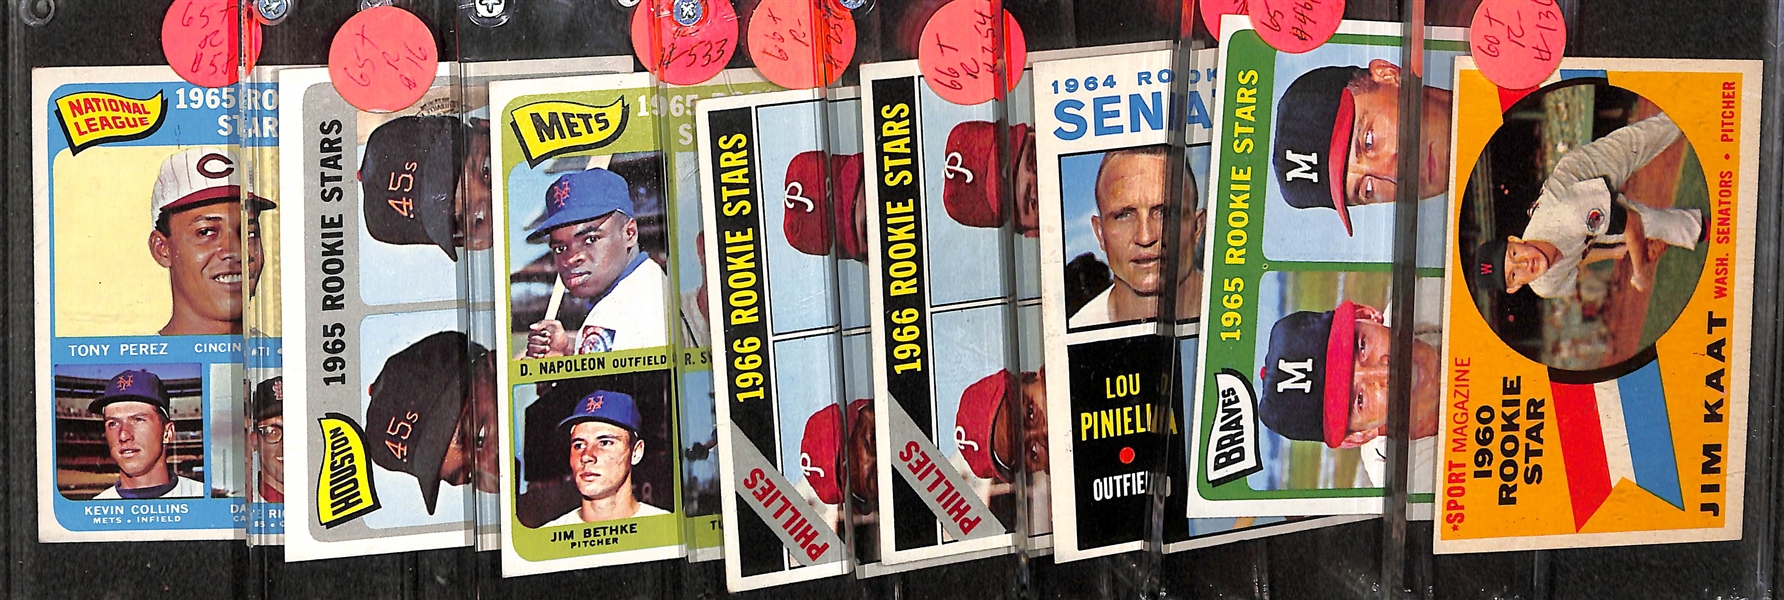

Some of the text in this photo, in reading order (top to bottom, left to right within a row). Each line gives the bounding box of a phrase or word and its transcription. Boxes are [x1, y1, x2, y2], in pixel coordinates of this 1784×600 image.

[68, 97, 151, 118] NATIONAL
[175, 87, 236, 109] 1965
[1051, 74, 1117, 94] 1964
[74, 115, 150, 137] LEAGUE
[529, 111, 611, 143] METS
[718, 133, 752, 217] STARS
[1285, 149, 1318, 184] M
[881, 102, 922, 375] 1966 ROOKIE STARS
[1220, 69, 1259, 342] 1965 ROOKIE STARS
[319, 118, 346, 387] 1965 ROOKIE STARS
[725, 227, 759, 326] ROOKIE
[1700, 81, 1736, 517] JIM KAAT WASH. SENATORS PITCHER
[68, 343, 110, 357] TONY
[120, 342, 169, 356] PEREZ
[520, 363, 533, 377] D.
[539, 356, 606, 376] NAPOLEON
[612, 354, 667, 369] OUTFIELD
[732, 336, 765, 403] 1966
[1277, 357, 1313, 394] M
[1105, 373, 1140, 399] LOU
[1213, 387, 1246, 472] BRAVES
[1446, 356, 1471, 524] SPORT MAGAZINE
[1473, 405, 1496, 479] 1960
[1498, 375, 1522, 506] ROOKIE
[1523, 397, 1545, 485] STAR
[329, 426, 363, 516] HOUSTON
[898, 440, 982, 536] PHILLIES
[84, 503, 189, 517] KEVIN COLLINS
[93, 514, 181, 524] METS INFIELD
[550, 523, 638, 543] JIM BETHKE
[570, 537, 619, 549] PITCHER
[743, 467, 830, 562] PHILLIES
